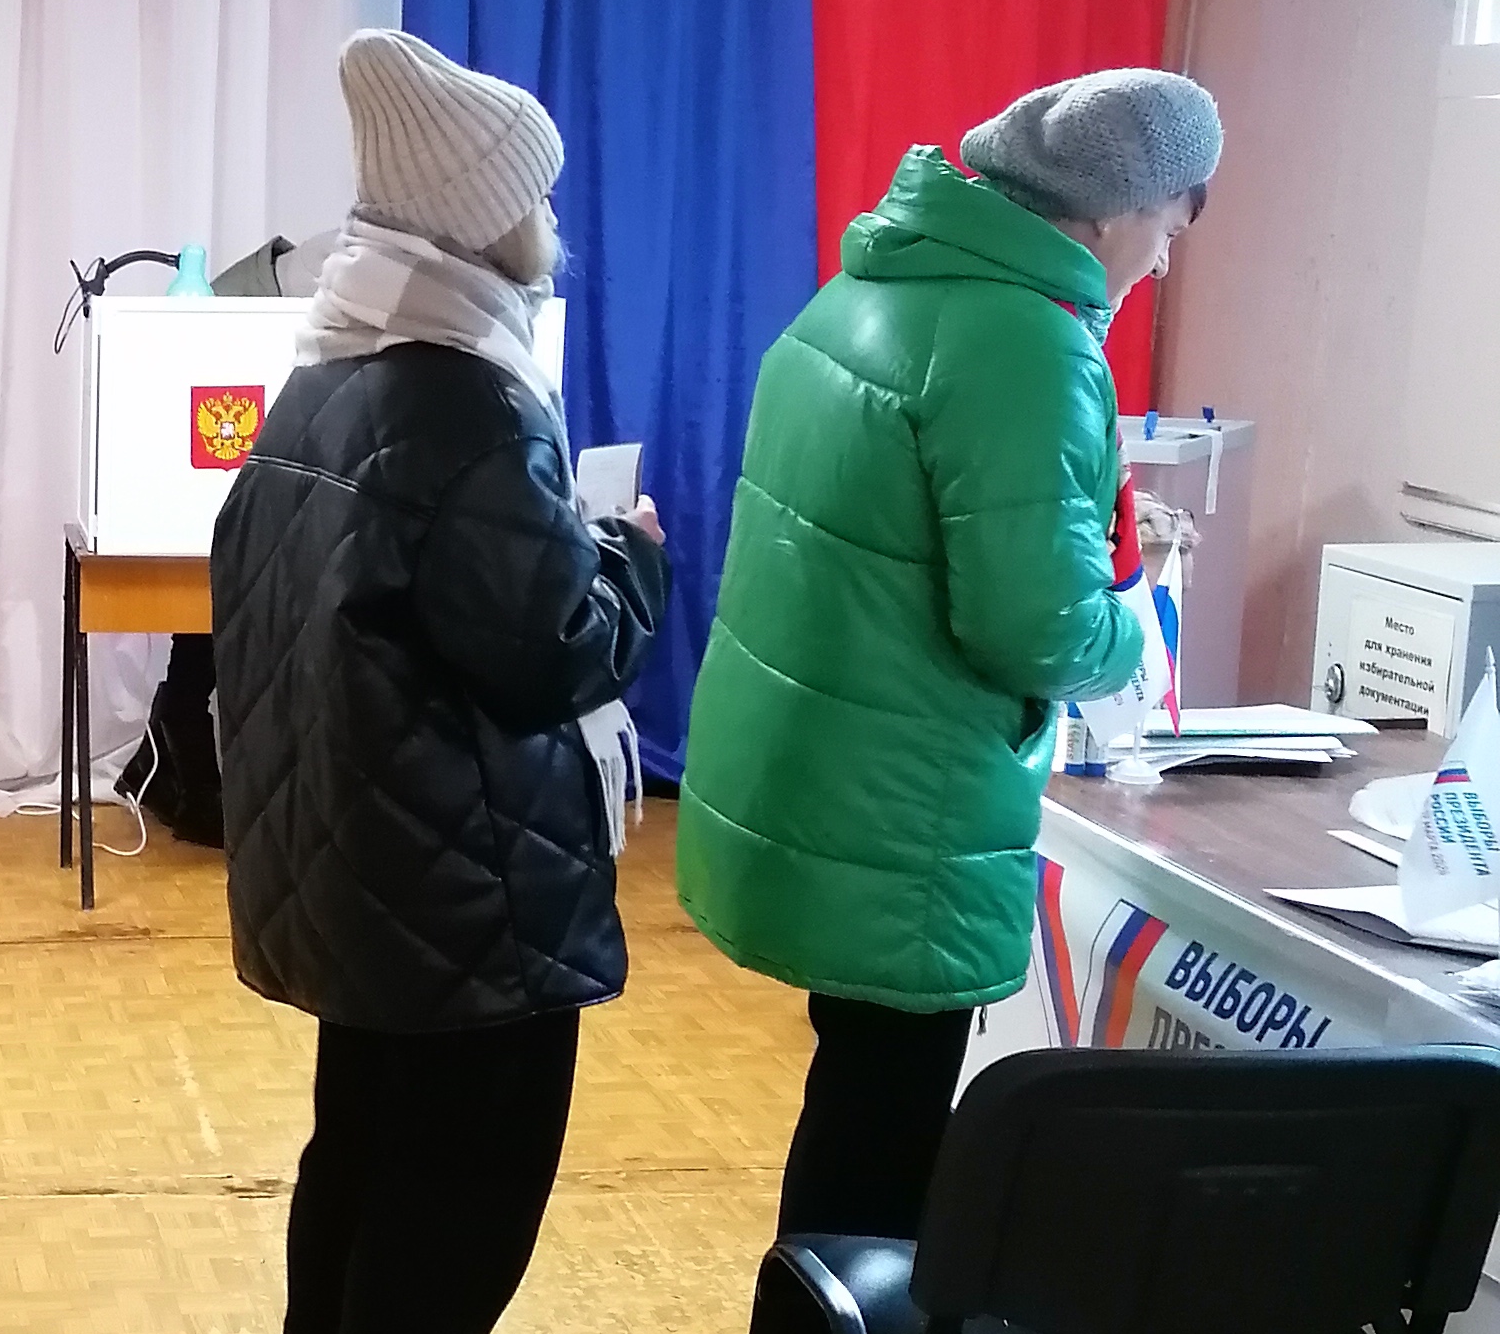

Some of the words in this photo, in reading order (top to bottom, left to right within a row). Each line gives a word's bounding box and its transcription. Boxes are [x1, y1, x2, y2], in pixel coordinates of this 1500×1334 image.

[1385, 616, 1415, 636] Место
[1364, 639, 1382, 651] для
[1385, 645, 1433, 668] хранения
[1359, 661, 1435, 693] избирательной
[1359, 685, 1430, 716] документации
[1430, 793, 1457, 844] РОССИИ
[1443, 792, 1492, 877] ПРЕЗИДЕНТА
[1462, 792, 1500, 852] ВЫБОРЫ
[1164, 940, 1333, 1049] ВЫБОРЫ
